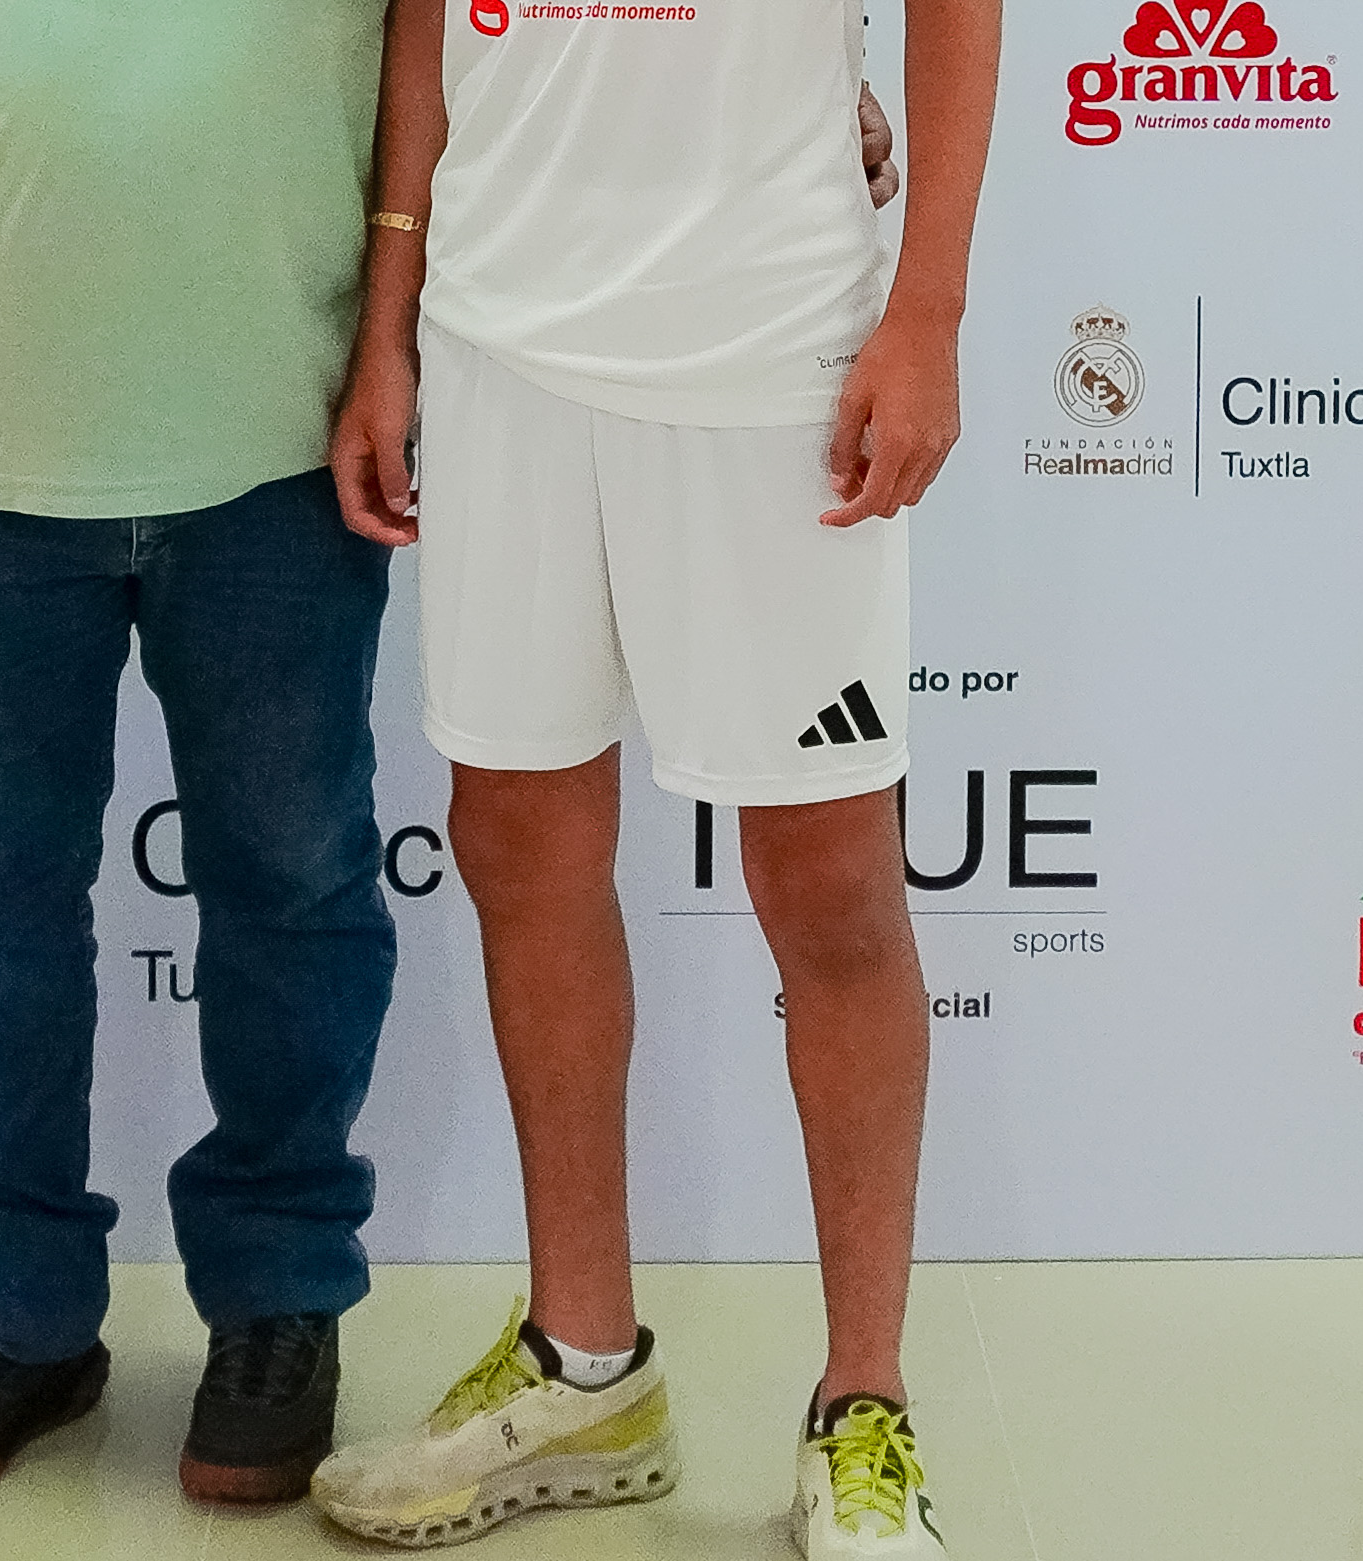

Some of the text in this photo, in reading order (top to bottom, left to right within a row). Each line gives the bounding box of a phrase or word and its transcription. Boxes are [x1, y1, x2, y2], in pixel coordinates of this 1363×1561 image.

[612, 5, 695, 20] momento
[1065, 53, 1338, 146] granvita
[1135, 114, 1330, 129] Nutrimos cada momento
[1025, 437, 1172, 449] FUNDACIÓN
[1025, 453, 1172, 475] Realmadrid
[1221, 452, 1309, 478] Tuxtla
[962, 669, 1019, 698] por
[1014, 929, 1104, 958] sports
